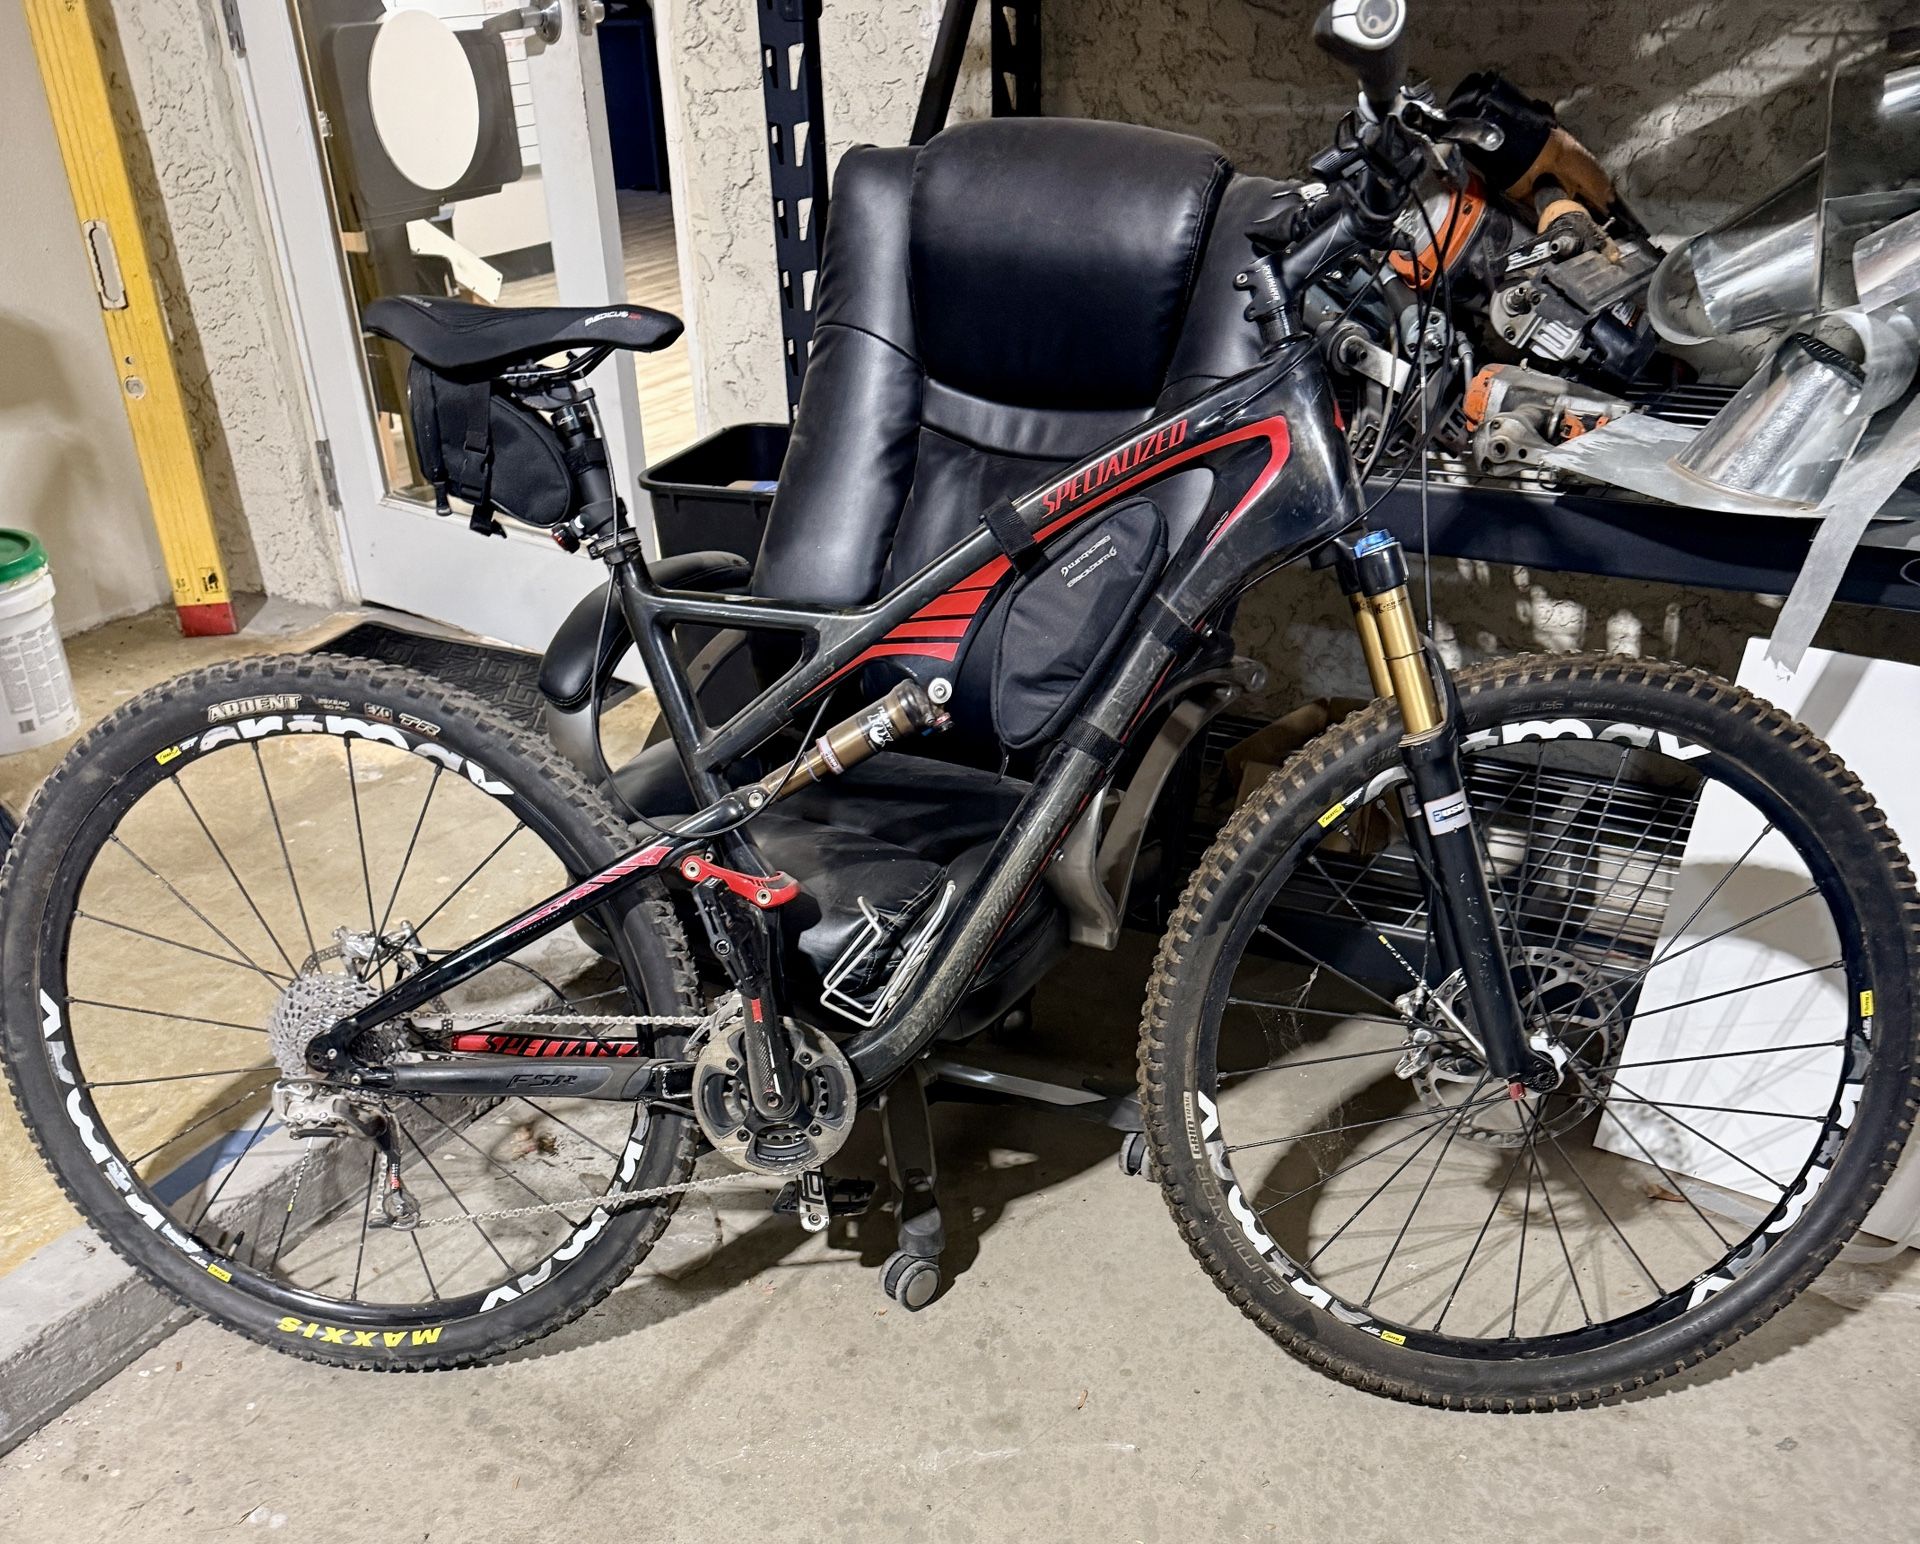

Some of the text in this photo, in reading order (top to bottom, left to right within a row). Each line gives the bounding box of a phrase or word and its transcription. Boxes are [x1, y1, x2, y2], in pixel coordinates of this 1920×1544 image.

[1042, 418, 1188, 519] SPECIALIZED
[208, 694, 301, 723] ARDENT
[366, 703, 392, 718] EXO
[399, 712, 441, 736] TR
[507, 1074, 578, 1089] FSR
[1185, 1096, 1201, 1155] GRID TRAIL
[1195, 1164, 1285, 1295] ELIMINATOR
[276, 1316, 444, 1348] MAXXIS
